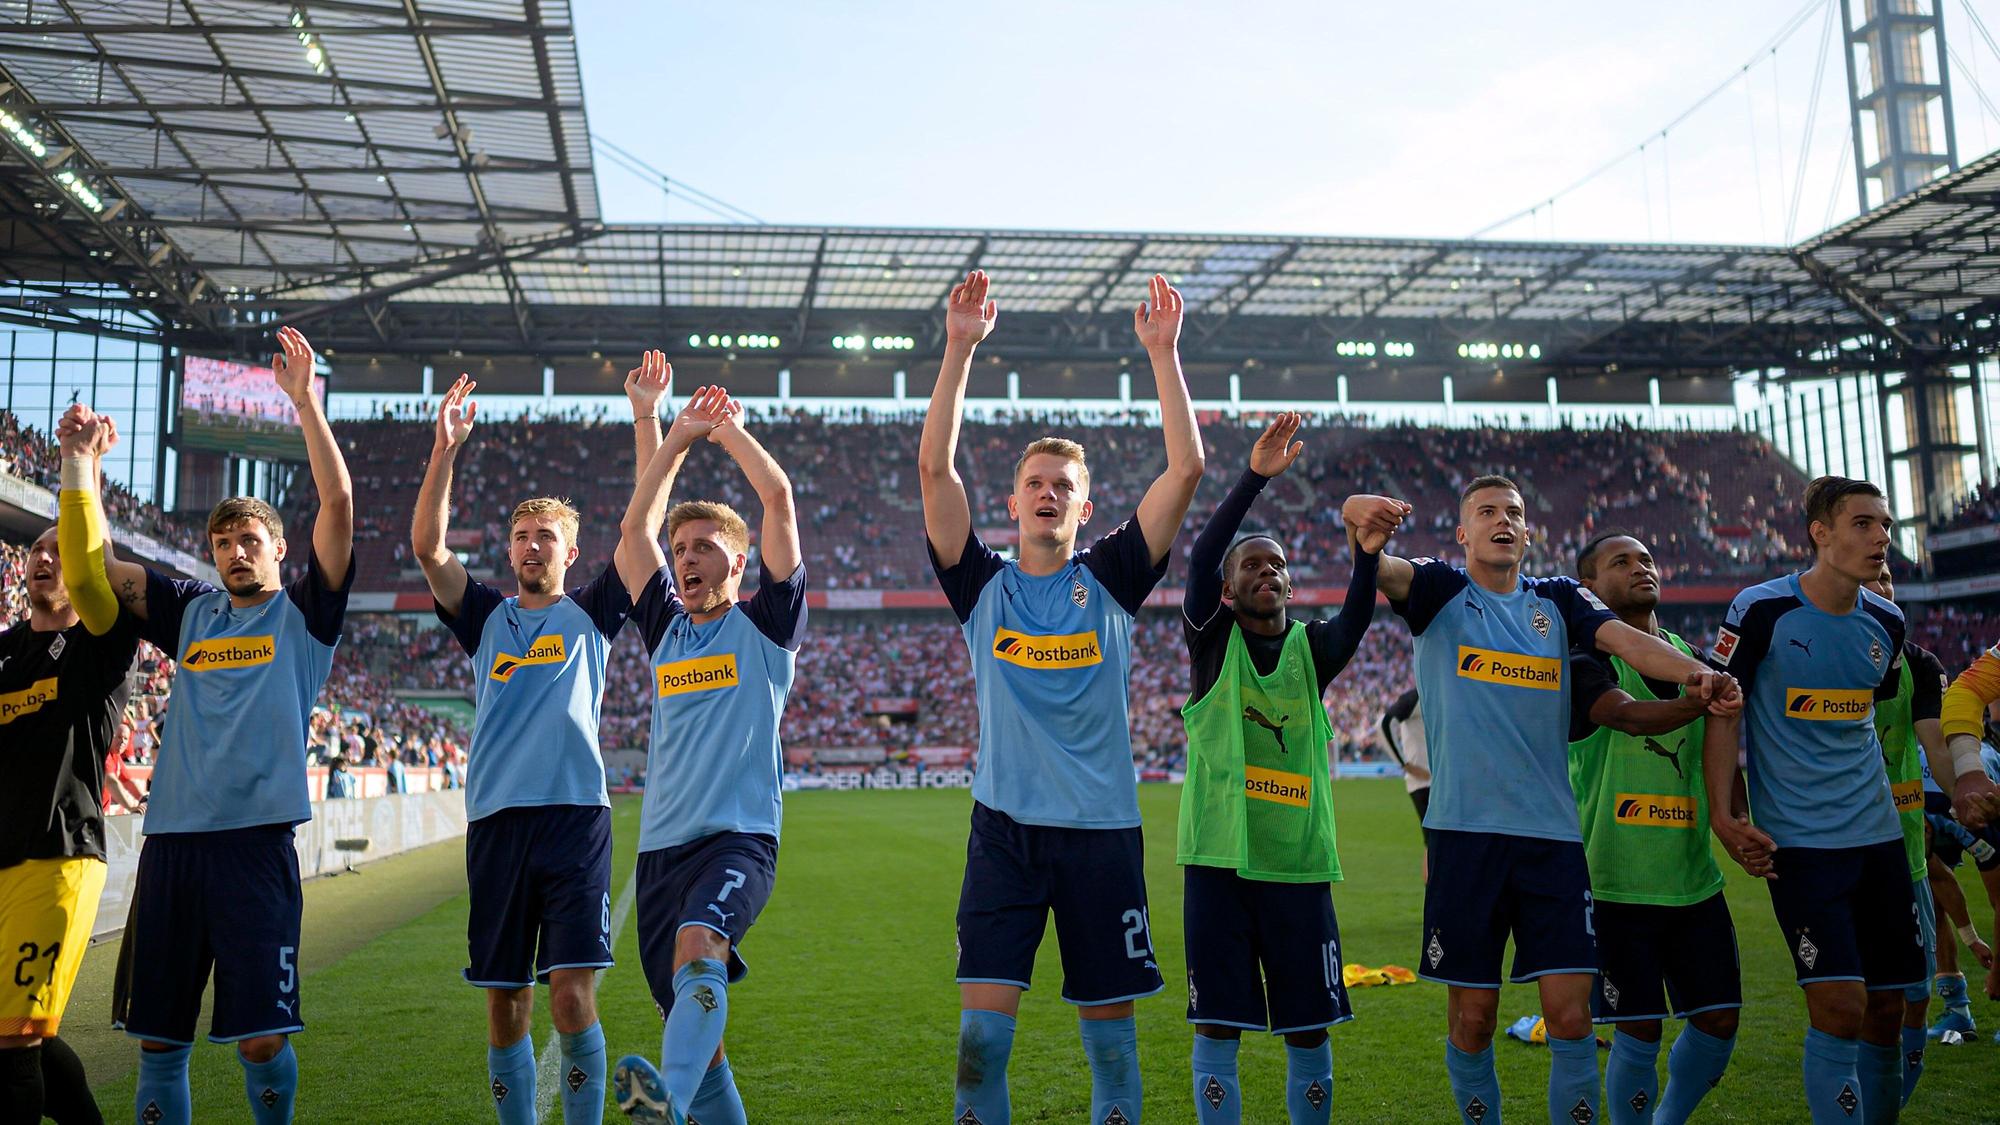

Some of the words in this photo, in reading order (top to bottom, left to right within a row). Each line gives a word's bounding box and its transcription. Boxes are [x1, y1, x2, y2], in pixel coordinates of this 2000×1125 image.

[202, 645, 272, 662] Postbank
[524, 643, 562, 659] bank
[1026, 642, 1097, 661] Postbank
[663, 664, 734, 689] Postbank
[1491, 661, 1558, 683] Postbank
[2, 689, 54, 717] Poba
[1823, 698, 1871, 713] Postba
[864, 772, 917, 789] NEUE
[920, 770, 975, 788] FORD
[1245, 779, 1308, 800] ostbank
[1893, 788, 1922, 806] bank
[717, 868, 747, 902] 7
[601, 891, 610, 934] 6
[1122, 905, 1153, 959] 2
[15, 941, 60, 987] 21
[279, 946, 295, 993] 5
[1322, 939, 1339, 988] 16
